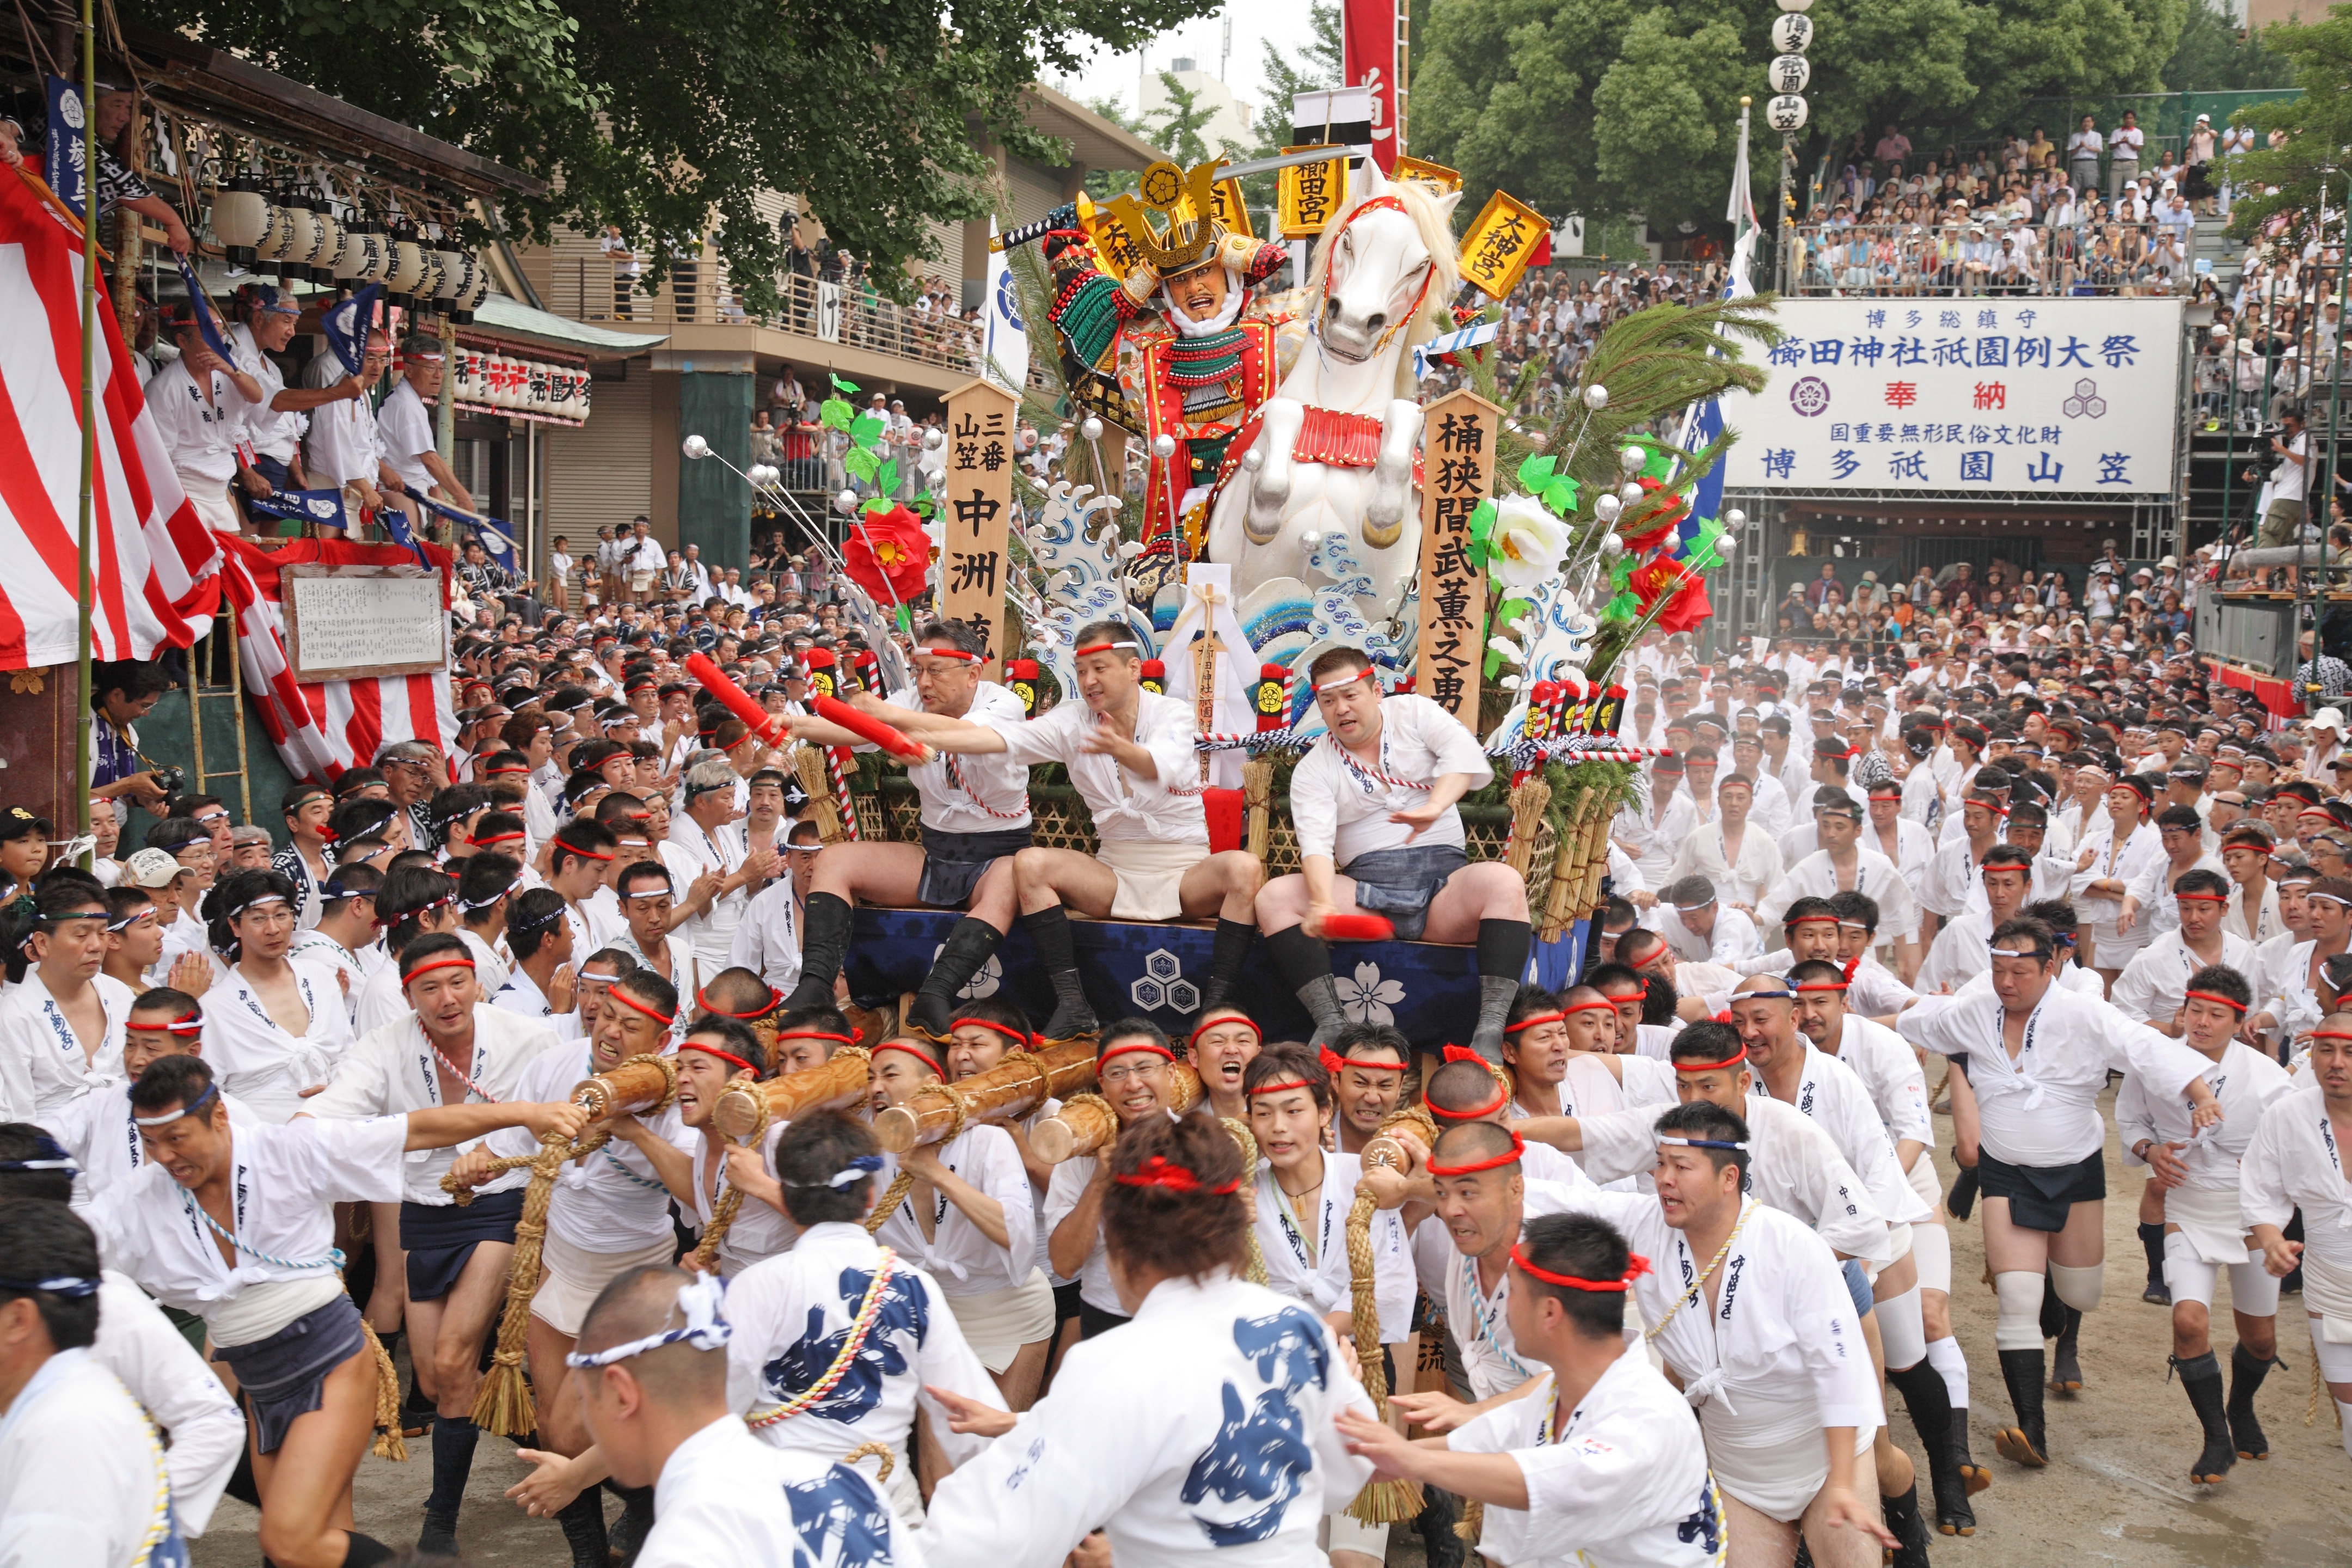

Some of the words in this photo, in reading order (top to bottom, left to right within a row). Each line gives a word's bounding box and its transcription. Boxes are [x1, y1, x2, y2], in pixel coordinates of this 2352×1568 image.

[1785, 15, 1809, 51] 博多
[1774, 96, 1800, 128] 山笠
[1294, 160, 1330, 225] 櫛田宮
[1472, 213, 1526, 280] 大神宮
[1866, 309, 2037, 328] 博多総鎮守
[1767, 335, 2140, 368] 櫛田神社祇園例大祭
[1884, 381, 2006, 410] 奉納
[954, 413, 981, 471] 山笠
[979, 413, 1007, 472] 三番
[1830, 423, 2061, 445] 国重要無形民俗文化財
[1761, 448, 2132, 484] 博多祇園山笠
[1430, 413, 1484, 715] 桶狭間武薫之勇
